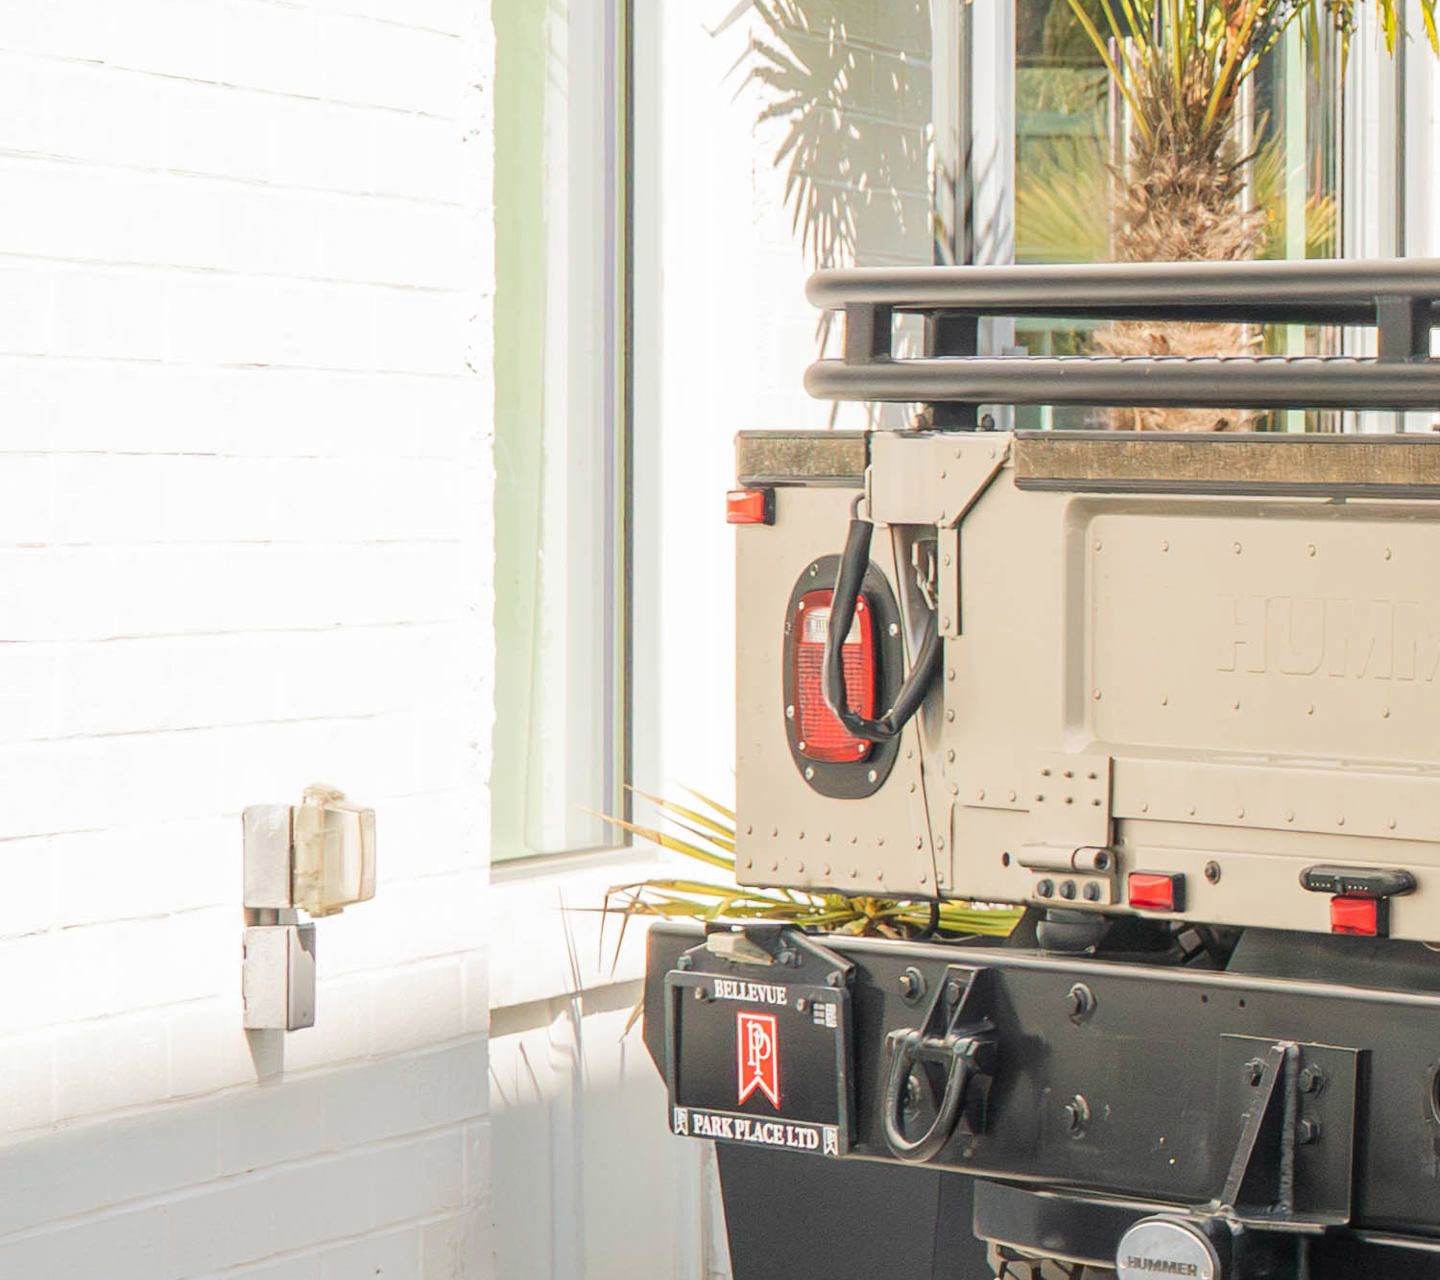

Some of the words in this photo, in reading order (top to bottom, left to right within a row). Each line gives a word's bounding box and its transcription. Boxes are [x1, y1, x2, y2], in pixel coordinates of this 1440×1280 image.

[714, 980, 787, 1005] BELLEVUE
[693, 1113, 734, 1139] PARK
[734, 1118, 786, 1146] PLACE
[786, 1125, 820, 1150] LTD
[1127, 1256, 1197, 1277] HUMMER
